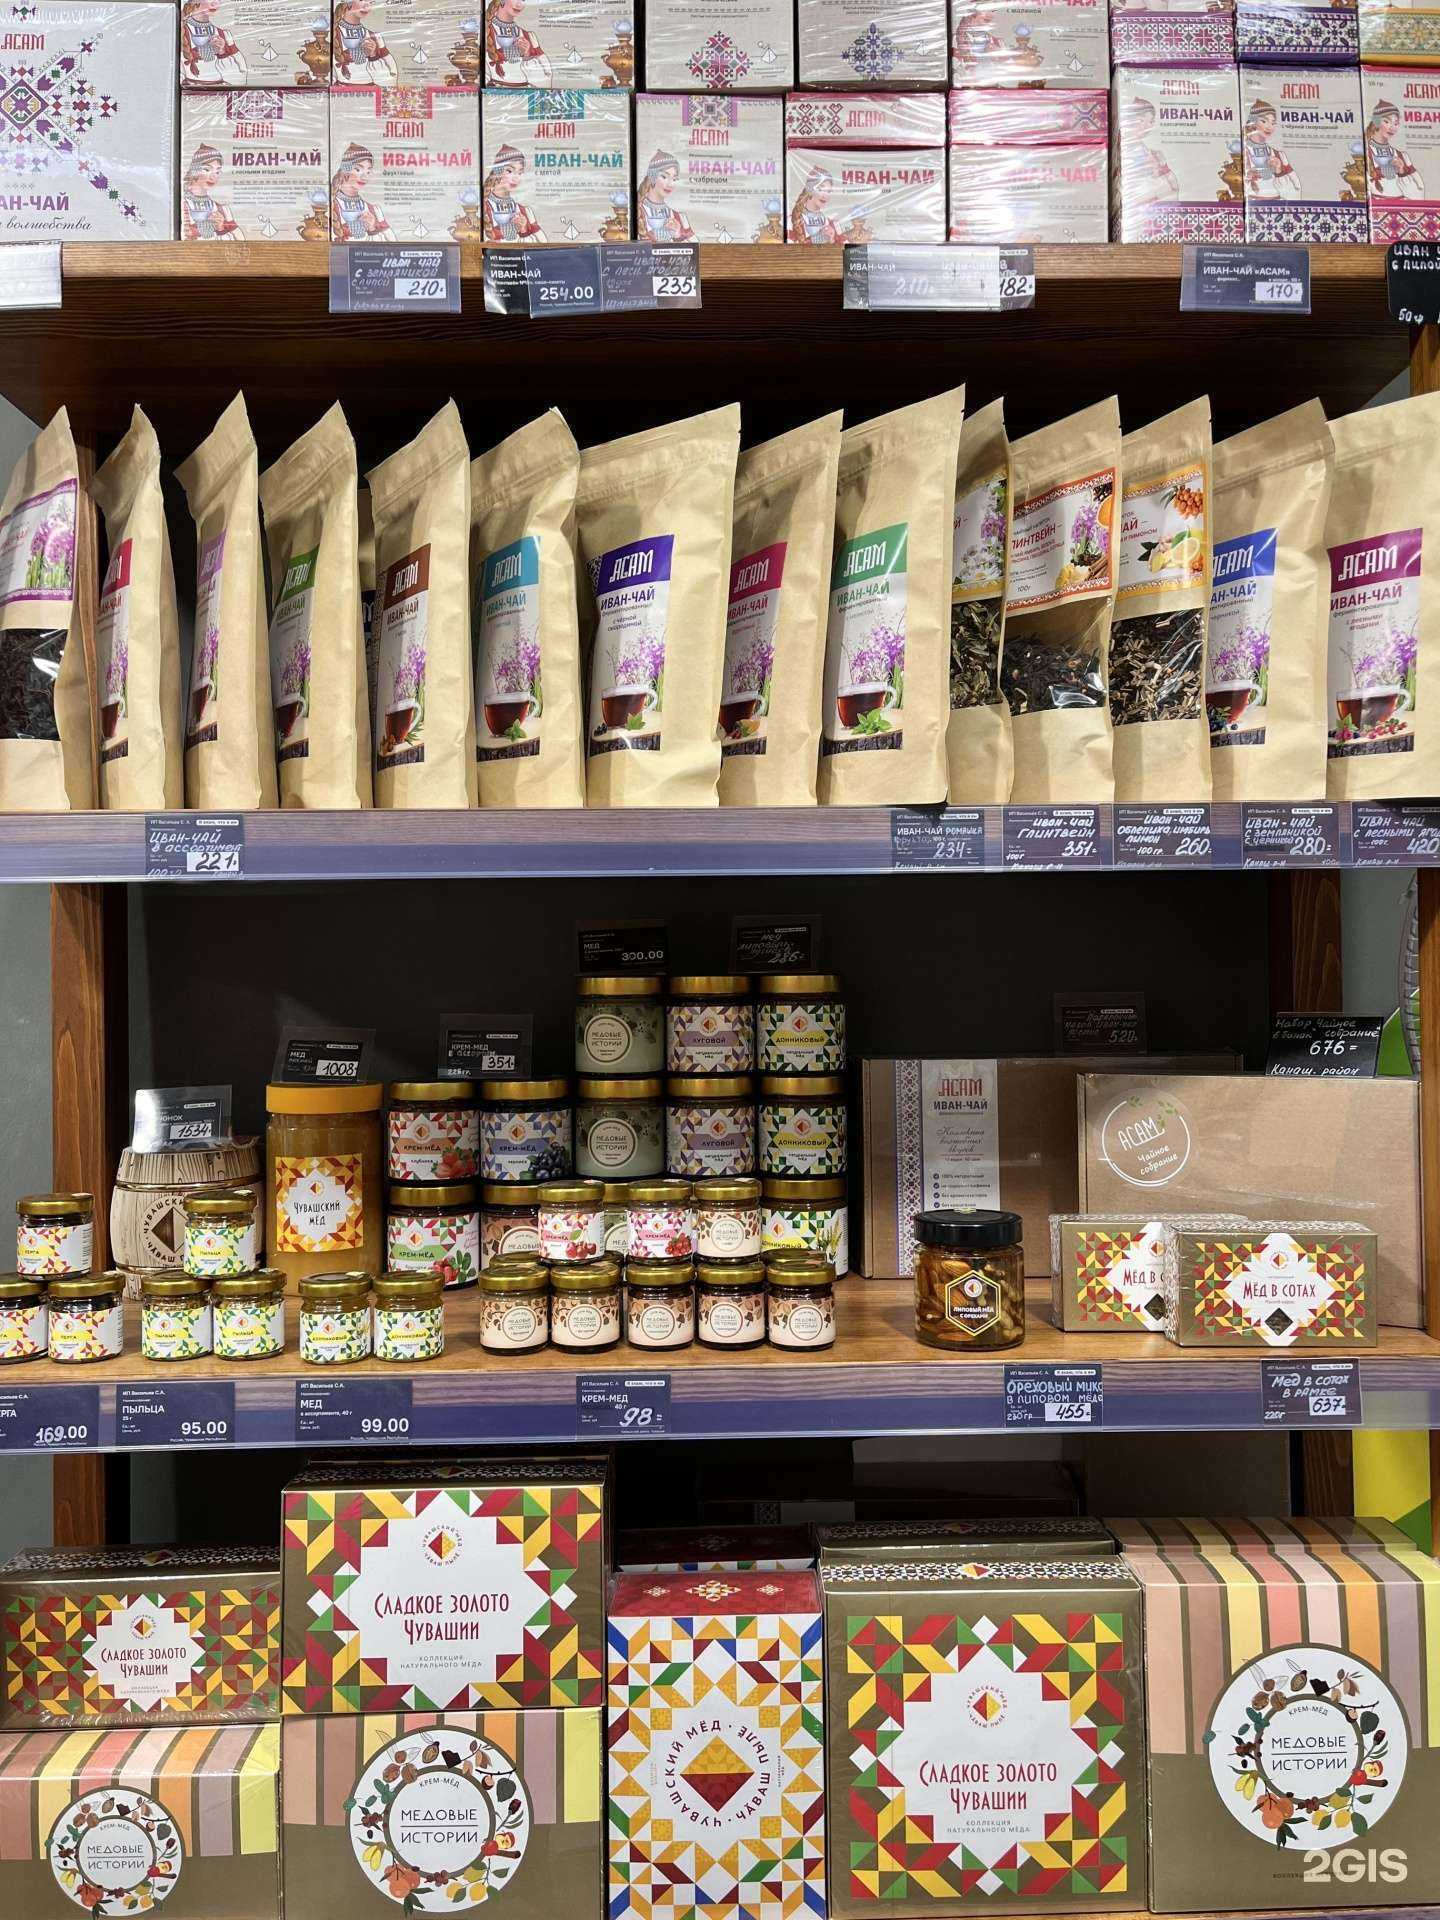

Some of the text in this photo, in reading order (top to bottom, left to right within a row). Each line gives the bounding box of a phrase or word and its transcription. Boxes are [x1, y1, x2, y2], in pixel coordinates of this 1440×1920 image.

[1, 33, 45, 50] АСАМ
[1280, 83, 1320, 99] АСАМ
[846, 110, 887, 128] АСАМ
[1160, 106, 1233, 121] ИВАН-ЧАЙ
[1280, 109, 1354, 124] ИВАН-ЧАЙ
[232, 121, 275, 139] АСАМ
[382, 120, 424, 139] АСАМ
[534, 121, 576, 139] АСАМ
[688, 128, 730, 147] АСАМ
[232, 147, 321, 166] ИВАН-ЧАЙ
[382, 149, 473, 167] ИВАН-ЧАЙ
[534, 150, 624, 168] ИВАН-ЧАЙ
[688, 158, 777, 175] ИВАН-ЧАЙ
[0, 191, 69, 211] АН-ЧАЙ
[6, 216, 92, 231] волшебства
[491, 269, 541, 279] ИВАН-ЧАЙ
[1203, 265, 1252, 275] ИВАН-ЧАЙ
[540, 287, 594, 301] 254.00
[1011, 522, 1056, 549] ЛИНТВЕЙН
[608, 549, 654, 584] АСАМ
[844, 541, 887, 577] АСАМ
[1338, 544, 1398, 582] АСАМ
[285, 560, 312, 590] АСАМ
[392, 560, 419, 597] АСАМ
[492, 551, 523, 588] АСАМ
[734, 558, 770, 594] АСАМ
[600, 585, 656, 611] ИВАН-ЧАЙ
[837, 579, 890, 607] ИВАН-ЧАЙ
[1210, 582, 1257, 605] АН-ЧАЙ
[1330, 582, 1403, 611] ИВАН-ЧАЙ
[387, 601, 420, 625] ИВАН-ЧАЙ
[486, 592, 527, 617] ИВАН-ЧАЙ
[897, 826, 943, 835] ИВАН-ЧАЙ
[1320, 1067, 1361, 1077] район
[938, 1078, 982, 1097] АСАМ
[933, 1099, 988, 1110] ИВАН-ЧАЙ
[1117, 1116, 1165, 1151] АСАМ
[1136, 1144, 1171, 1164] Чайное
[1139, 1153, 1179, 1176] собрание
[143, 1197, 184, 1229] ЧУВАШСКИ
[294, 1202, 341, 1216] ЧУВАШСКИЙ
[309, 1214, 325, 1226] МЁД
[1282, 1284, 1316, 1298] СОТАХ
[300, 1399, 323, 1410] МЕД
[582, 1394, 629, 1403] КРЕМ-МЕД
[122, 1405, 165, 1415] ПЫЛЬЦА
[181, 1421, 227, 1435] 95.00
[361, 1418, 409, 1433] 99.00
[374, 1592, 509, 1618] СЛАДКОЕ ЗОЛОТО
[404, 1619, 480, 1645] ЧУВАШИИ
[101, 1647, 187, 1664] СЛАДКОЕ ЗОЛОТО
[400, 1659, 483, 1669] НАТУРАЛЬНОГО МЁДА
[120, 1663, 168, 1678] ЧУВАШИИ
[1288, 1705, 1329, 1717] КРЕМ-МЁД
[685, 1720, 722, 1739] МЁД
[1271, 1735, 1347, 1749] МЕДОВЫЕ
[919, 1760, 1058, 1787] СЛАДКОЕ ЗОЛОТО
[1271, 1758, 1347, 1771] ИСТОРИИ
[419, 1777, 460, 1789] КРЕМ-МЁД
[664, 1741, 722, 1827] ЧУВАШСКИЙ
[950, 1788, 1028, 1814] ЧУВАШИИ
[401, 1808, 478, 1821] МЕДОВЫЕ
[401, 1831, 478, 1844] ИСТОРИИ
[1009, 1825, 1031, 1833] МЁДА
[87, 1844, 143, 1854] МЕДОВЫЕ
[87, 1861, 145, 1870] ИСТОРИИ
